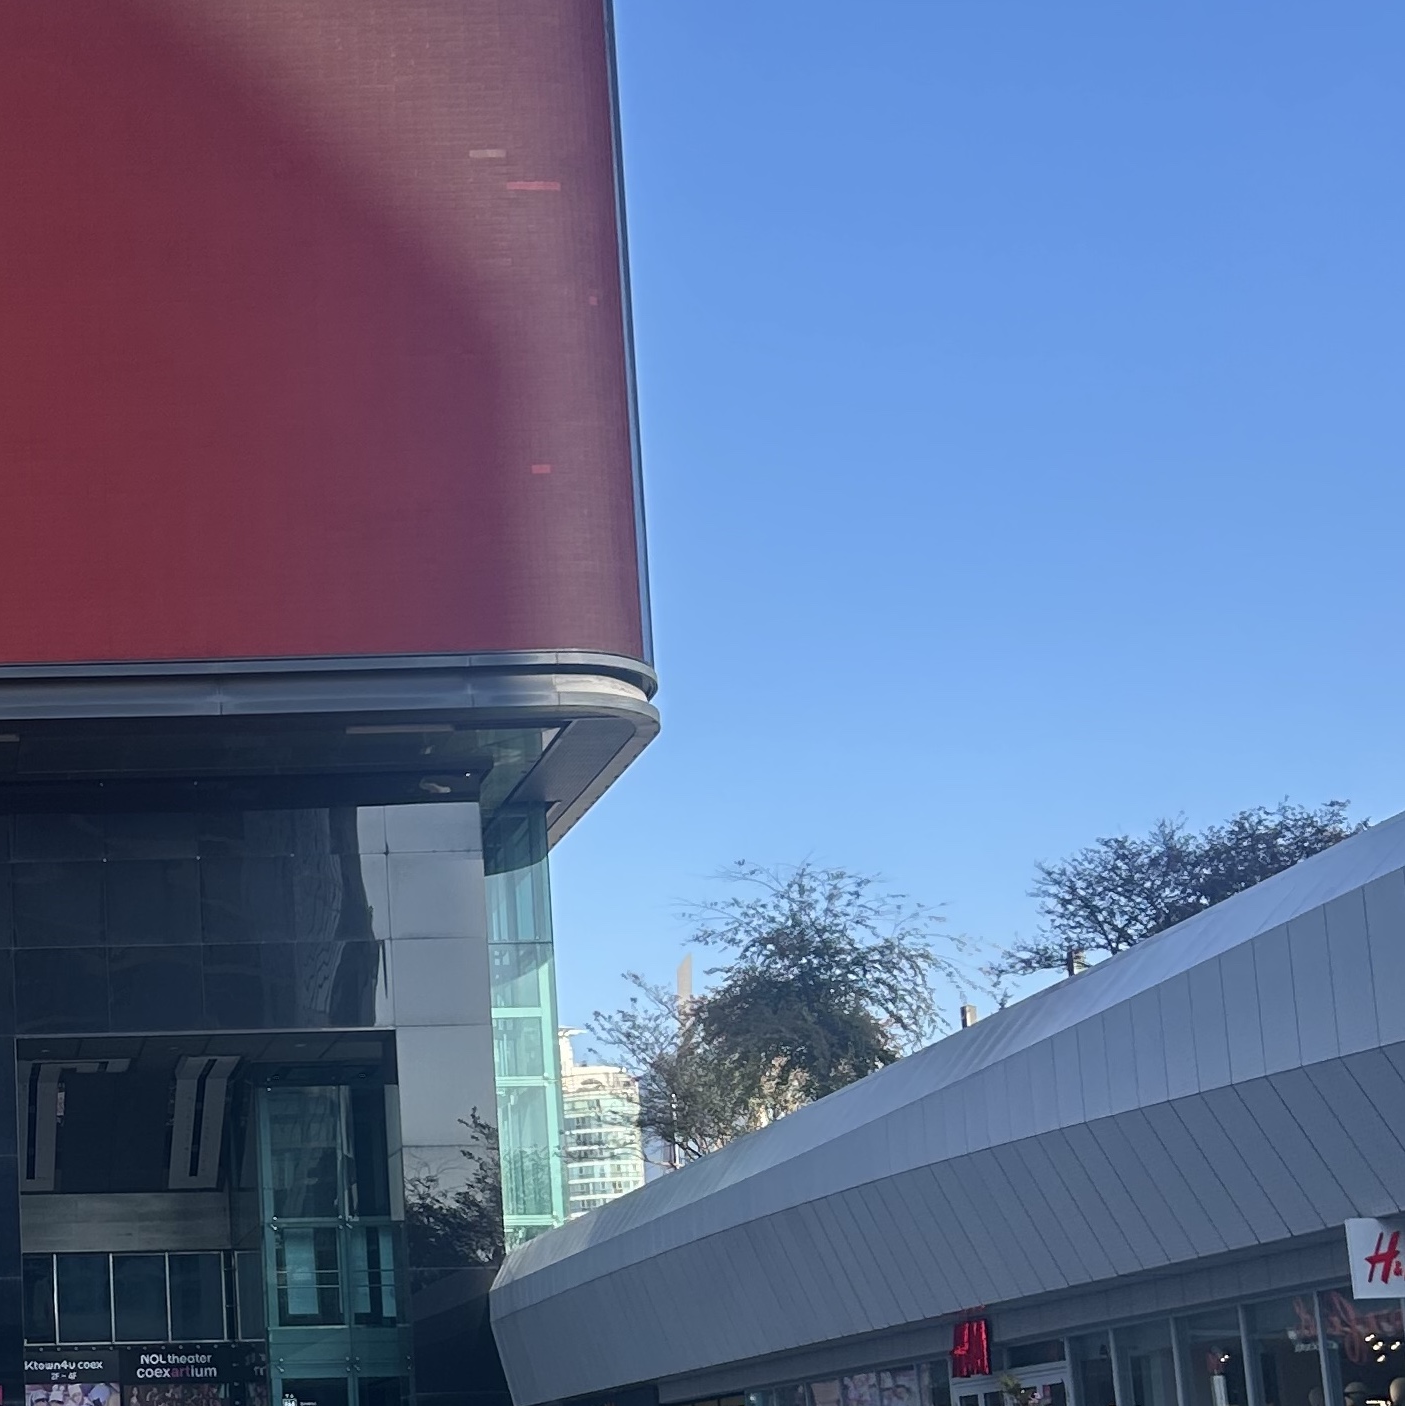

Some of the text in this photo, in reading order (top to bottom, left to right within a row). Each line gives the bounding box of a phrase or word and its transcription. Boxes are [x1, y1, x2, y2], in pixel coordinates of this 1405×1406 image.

[1364, 1230, 1405, 1285] H&
[140, 1353, 212, 1365] NOL theater
[24, 1360, 103, 1371] Ktown4u coex
